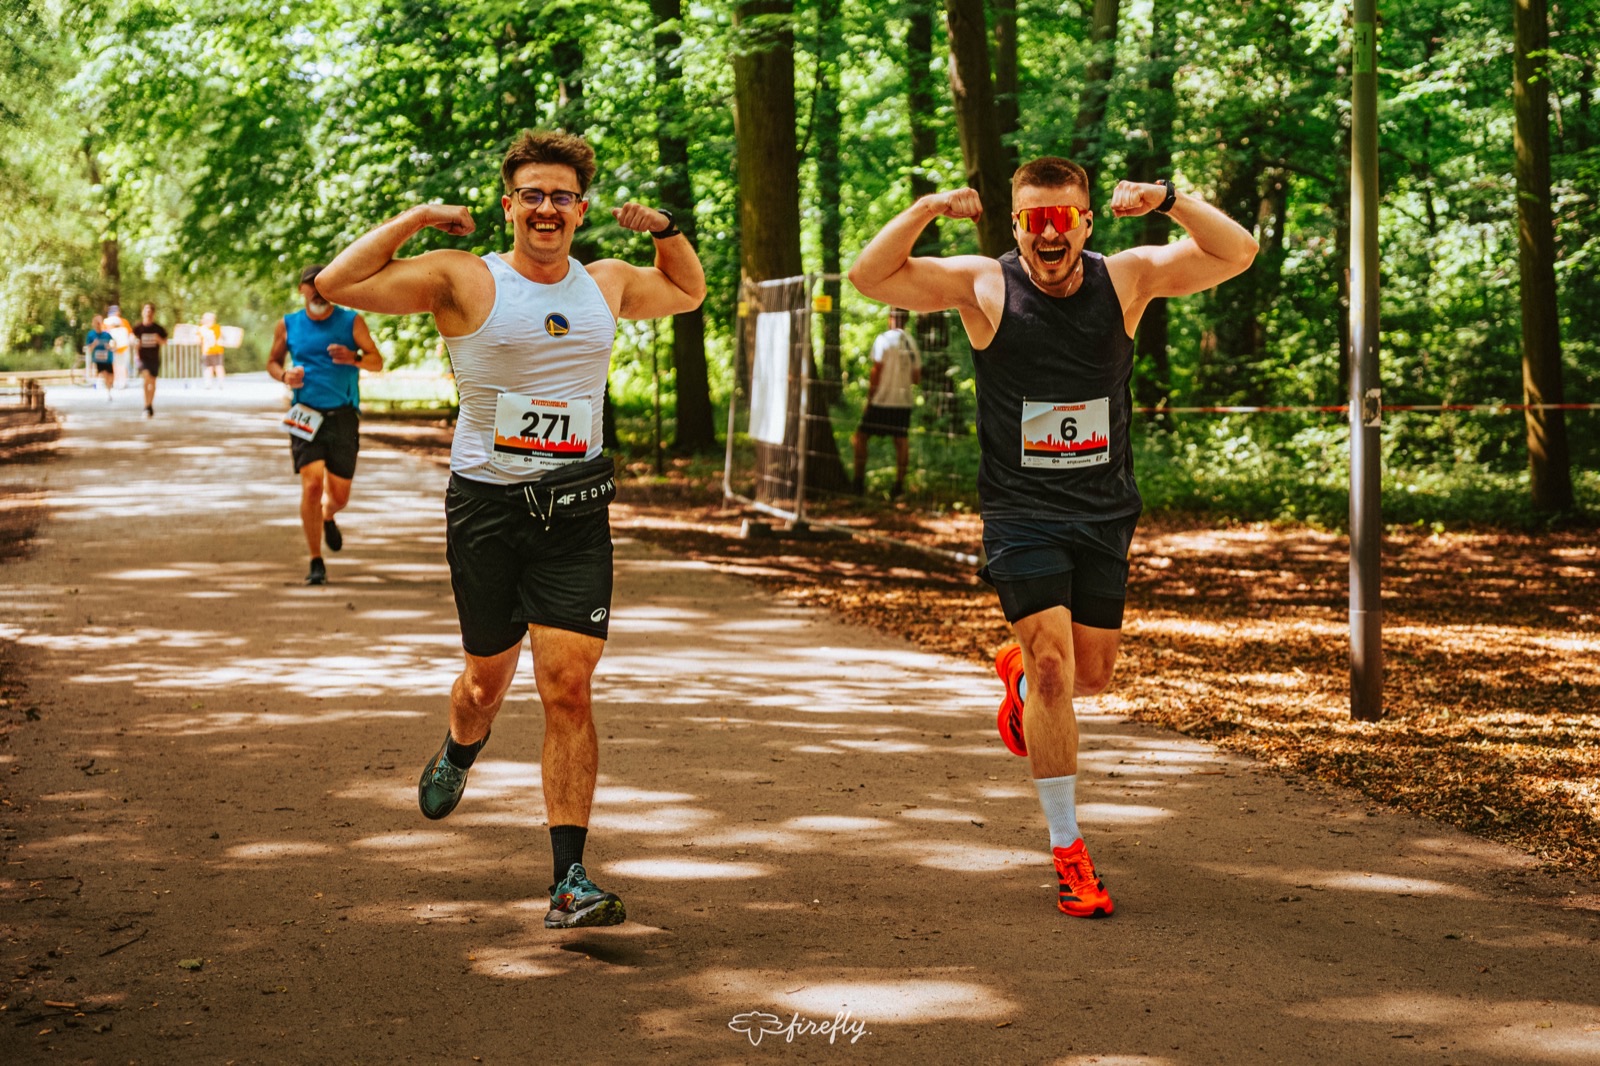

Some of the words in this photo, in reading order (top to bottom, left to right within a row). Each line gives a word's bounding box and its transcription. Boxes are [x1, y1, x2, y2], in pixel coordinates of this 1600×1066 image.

[520, 411, 571, 441] 271
[1060, 416, 1078, 441] 6
[556, 493, 577, 506] 4F
